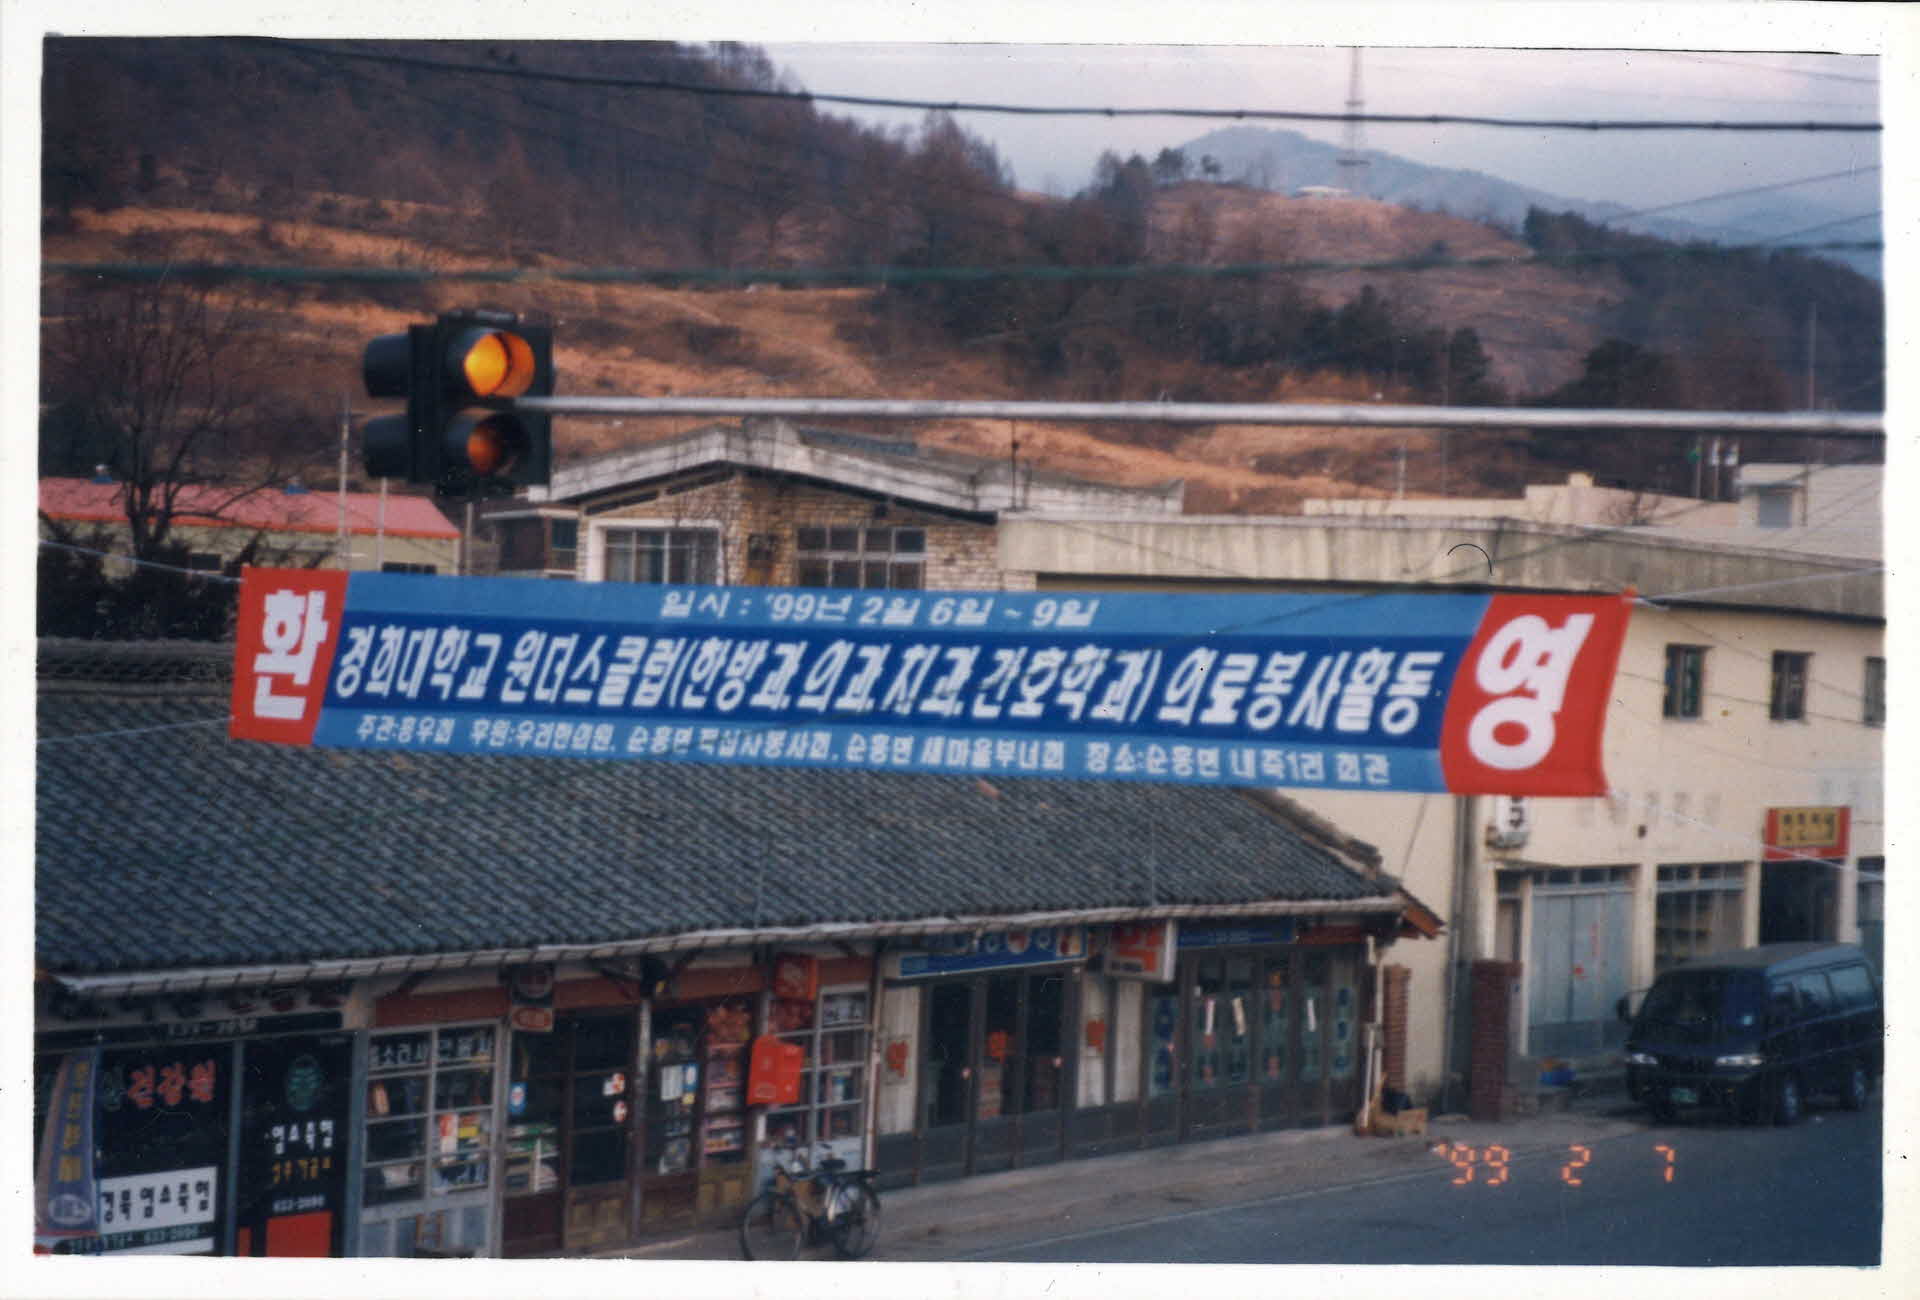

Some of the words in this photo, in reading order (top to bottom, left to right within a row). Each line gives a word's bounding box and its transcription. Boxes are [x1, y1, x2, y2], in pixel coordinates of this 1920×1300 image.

[253, 589, 328, 720] 환
[660, 589, 731, 620] 일시
[859, 597, 921, 626] 2월
[928, 599, 995, 627] 6일
[1033, 601, 1099, 629] 9일
[336, 624, 502, 701] 경희대학교
[1157, 646, 1445, 735] 의료봉사활동
[1467, 613, 1596, 771] 영
